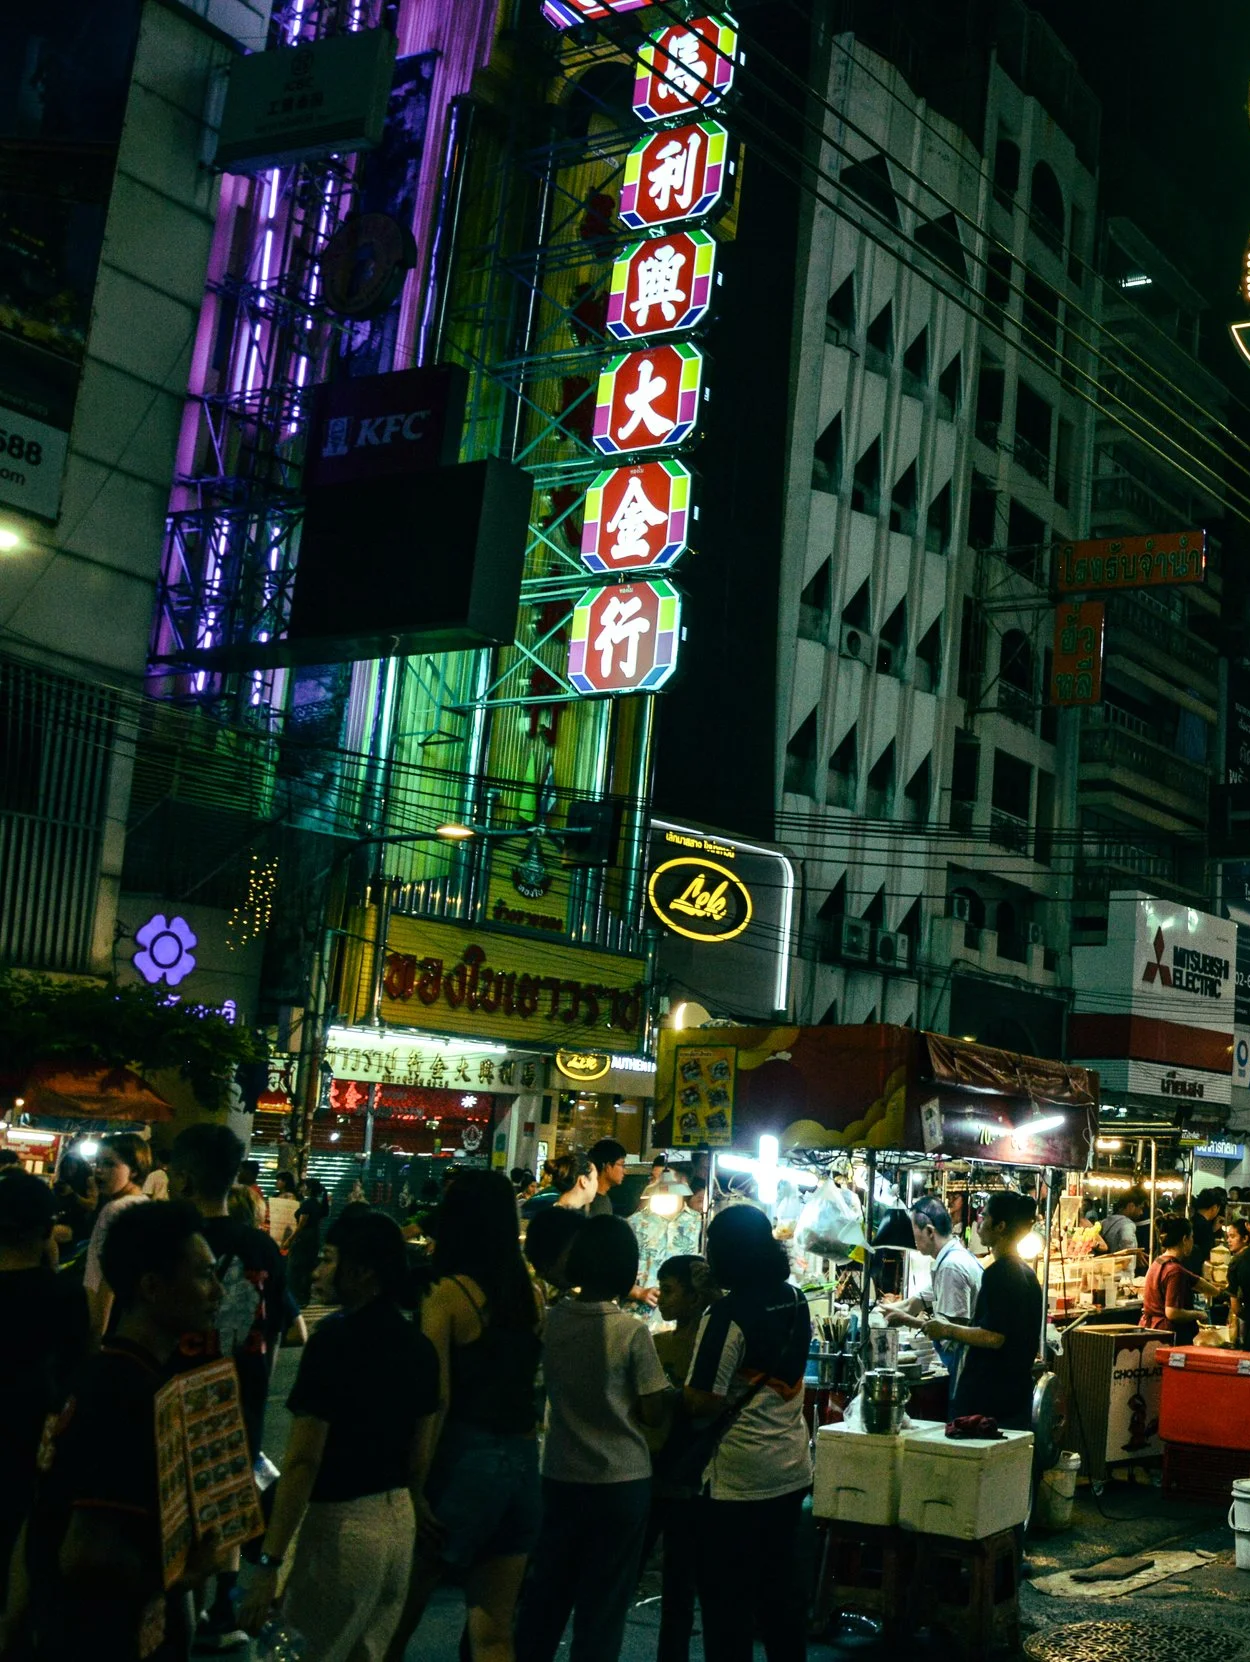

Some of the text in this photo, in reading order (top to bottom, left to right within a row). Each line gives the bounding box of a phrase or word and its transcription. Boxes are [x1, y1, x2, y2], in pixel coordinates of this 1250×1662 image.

[354, 409, 431, 448] KFC
[0, 429, 42, 467] 88
[1063, 536, 1201, 584] โรงรับจำนำ
[669, 873, 728, 921] Lek
[1172, 945, 1229, 980] MITSUBISHI
[1172, 967, 1222, 999] ELECTRIC
